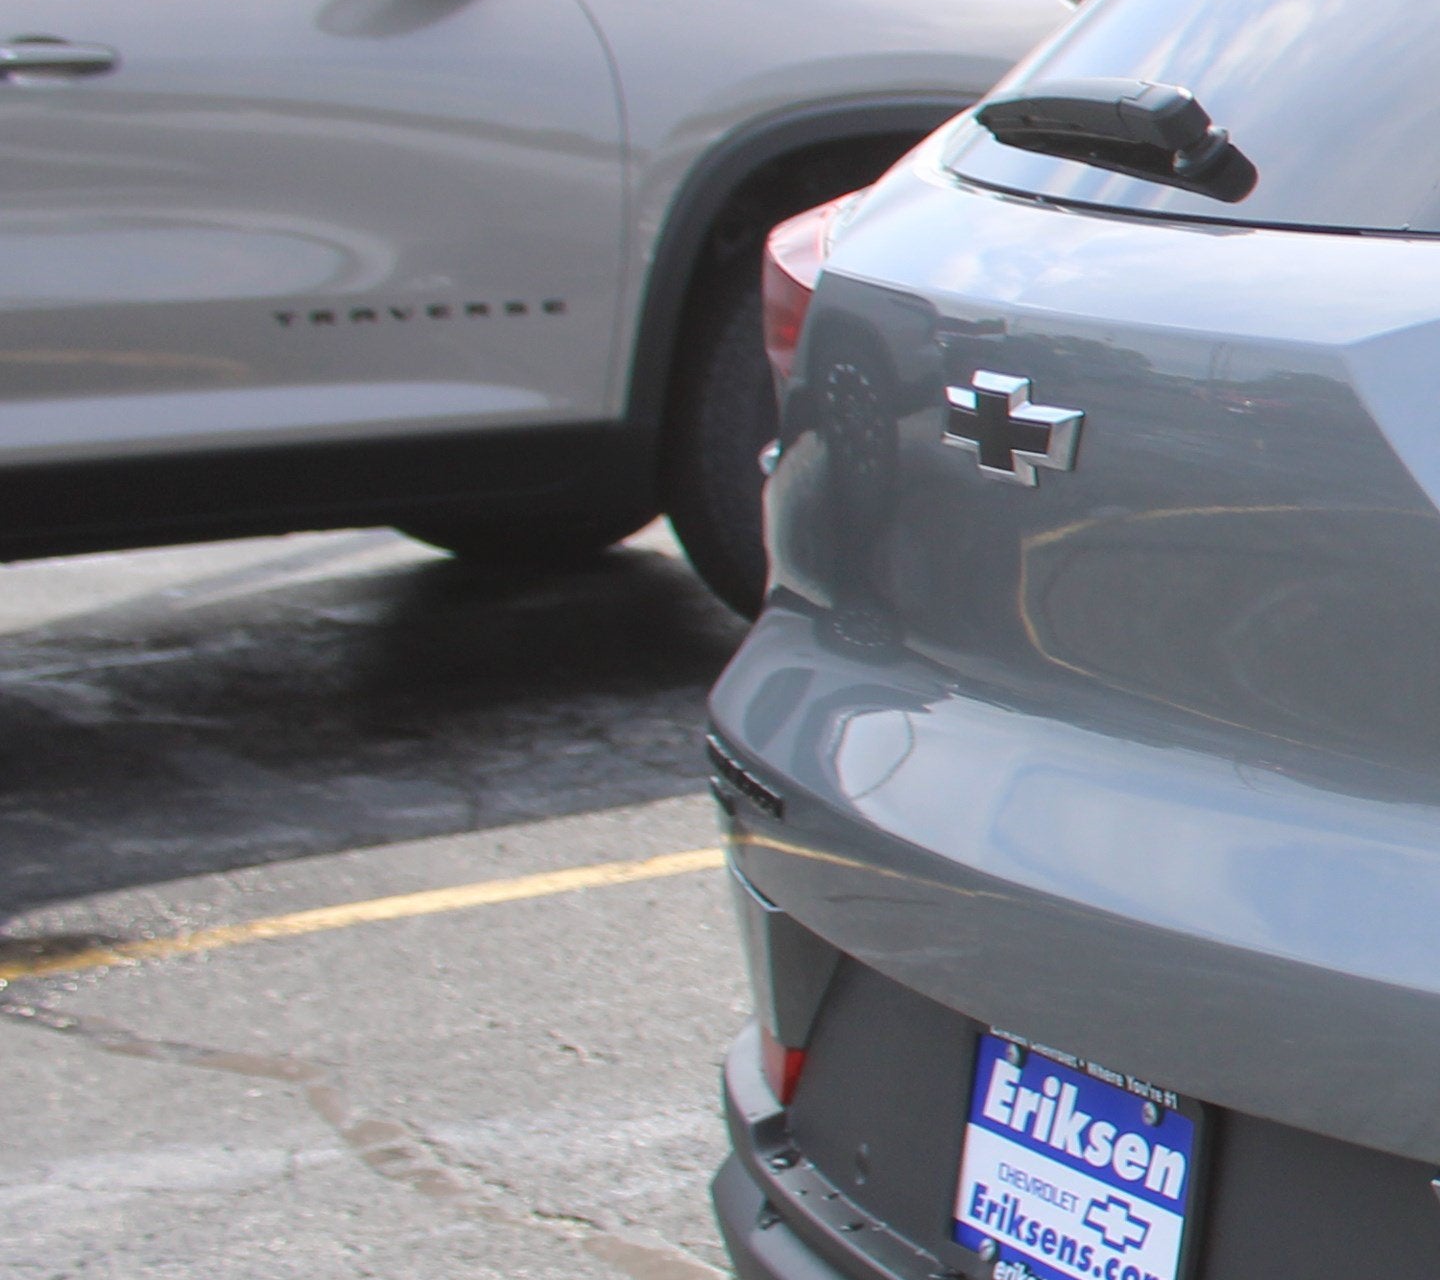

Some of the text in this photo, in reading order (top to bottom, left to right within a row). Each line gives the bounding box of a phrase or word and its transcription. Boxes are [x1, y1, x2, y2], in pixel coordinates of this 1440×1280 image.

[273, 299, 567, 325] TRAVERSE
[982, 1058, 1186, 1200] Eriksen
[999, 1162, 1079, 1213] CHEVROLET
